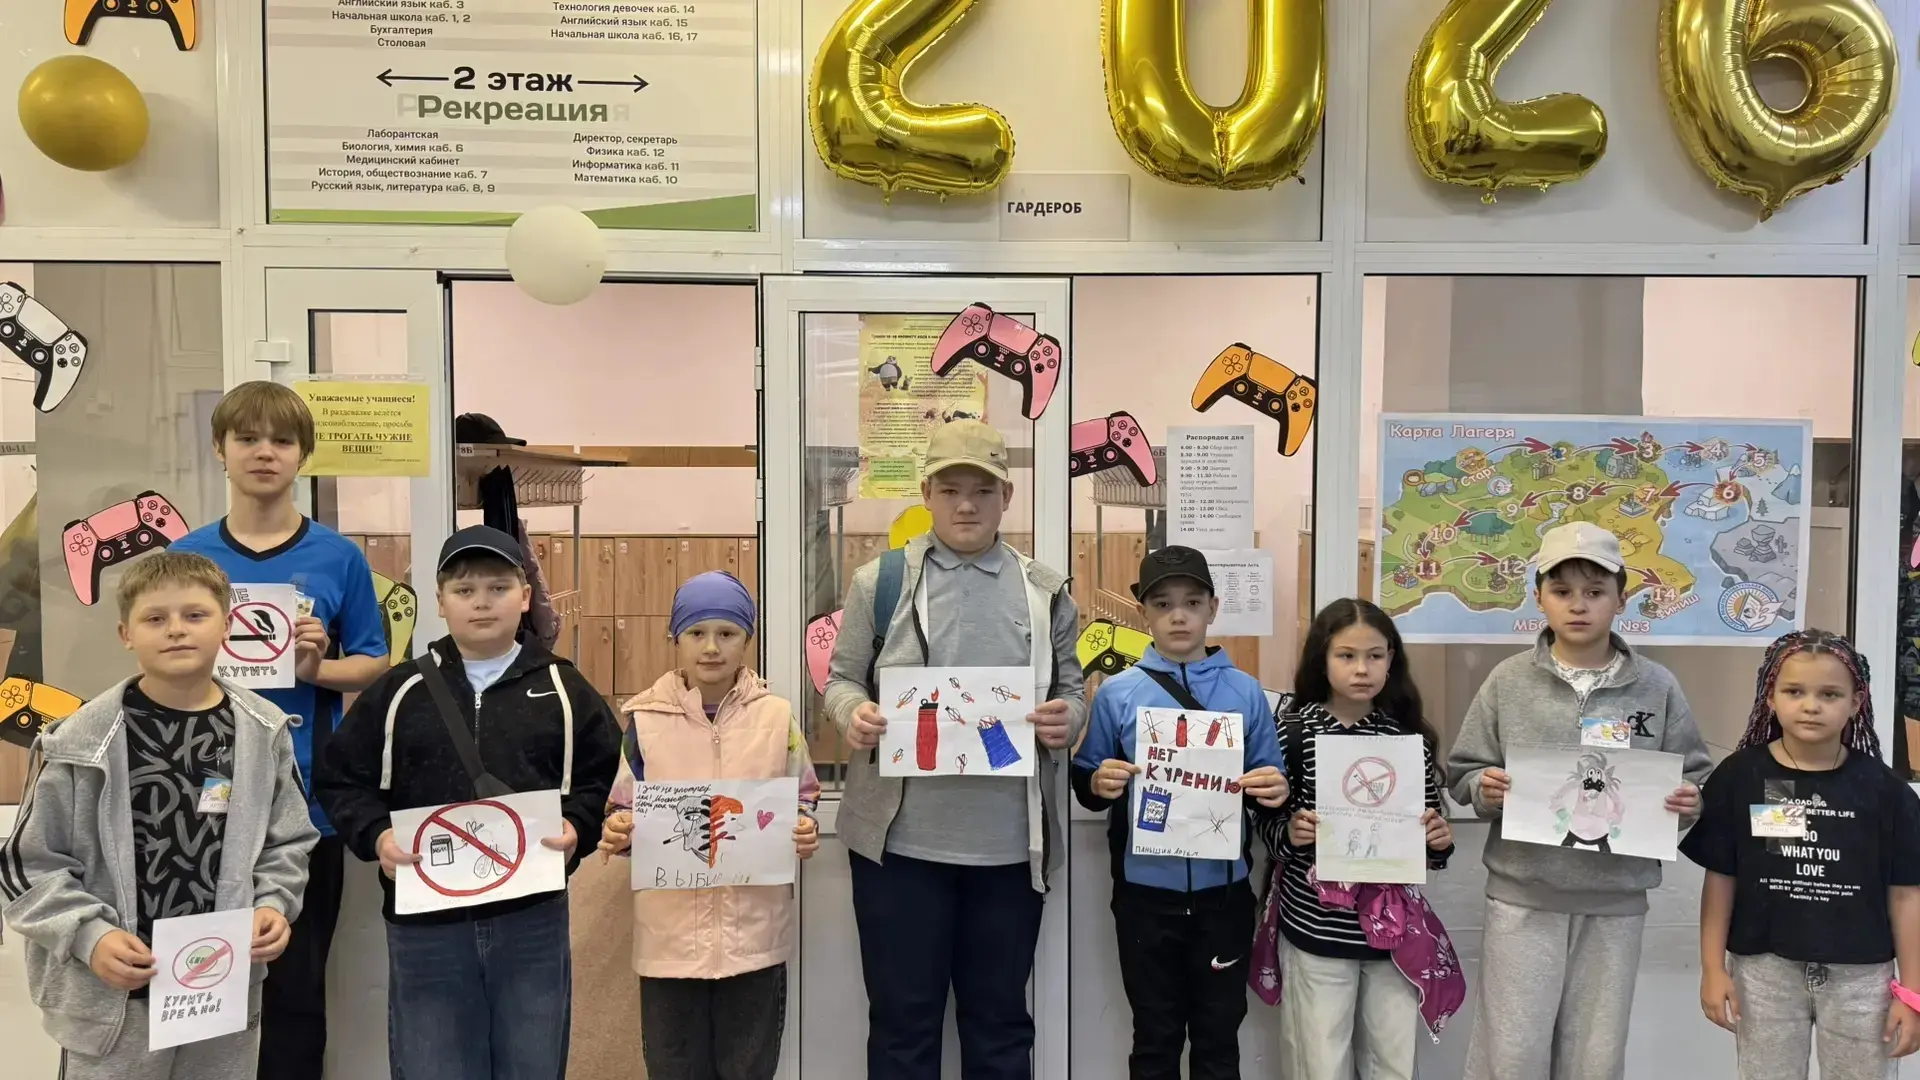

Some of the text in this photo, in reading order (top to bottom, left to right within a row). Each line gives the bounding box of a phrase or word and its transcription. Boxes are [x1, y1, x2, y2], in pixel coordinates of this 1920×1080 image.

[400, 0, 427, 9] язык
[429, 1, 453, 9] каб.
[456, 1, 464, 9] 3
[552, 2, 695, 14] Технология девочек каб. 14
[332, 10, 471, 24] Начальная школа каб. 1, 2
[560, 15, 688, 27] Английский язык каб. 15
[370, 25, 433, 36] Бухгалтерия
[550, 29, 698, 42] Начальная школа каб. 16, 17
[377, 38, 426, 48] Столовая
[453, 66, 574, 92] 2 этаж
[418, 95, 608, 125] Рекреация
[367, 129, 439, 140] Лаборантская
[573, 133, 678, 146] Директор, секретарь
[341, 141, 464, 153] Биология, химия каб. 6
[586, 146, 665, 157] Физика каб. 12
[346, 154, 460, 166] Медицинский кабинет
[572, 160, 680, 171] Информатика каб. 11
[318, 168, 488, 180] История, обществознание каб. 7
[574, 173, 678, 184] Математика каб. 10
[311, 181, 495, 194] Русский язык, литература каб. 8, 9
[1007, 202, 1082, 217] ГАРДЕРОБ
[308, 393, 416, 405] Уважаемые учащиеся!
[327, 432, 373, 440] ТРОГАТЬ
[375, 433, 413, 441] ЧУЖИЕ
[1186, 434, 1229, 442] Распорядок
[1389, 424, 1515, 440] Карта Лагеря
[1643, 443, 1654, 458] 3
[1709, 443, 1722, 456] 4
[1753, 452, 1766, 467] 5
[1461, 464, 1498, 488] Старт
[1573, 487, 1584, 500] 8
[1643, 487, 1655, 501] 7
[1723, 485, 1736, 499] 6
[1506, 504, 1519, 517] 9
[1430, 527, 1455, 541] 10
[1416, 561, 1439, 576] 11
[1502, 560, 1525, 574] 12
[1654, 587, 1677, 601] 14
[1655, 593, 1700, 620] ФИНИШ
[1618, 619, 1651, 632] №3
[217, 665, 278, 678] КУРИТЬ
[1147, 745, 1178, 763] НЕТ
[1806, 808, 1856, 818] BETTER LIFE
[1781, 845, 1840, 861] WHAT YOU
[1796, 863, 1826, 877] LOVE
[163, 991, 213, 1009] КУРИТЬ
[160, 998, 222, 1023] ВРЕДНО!
